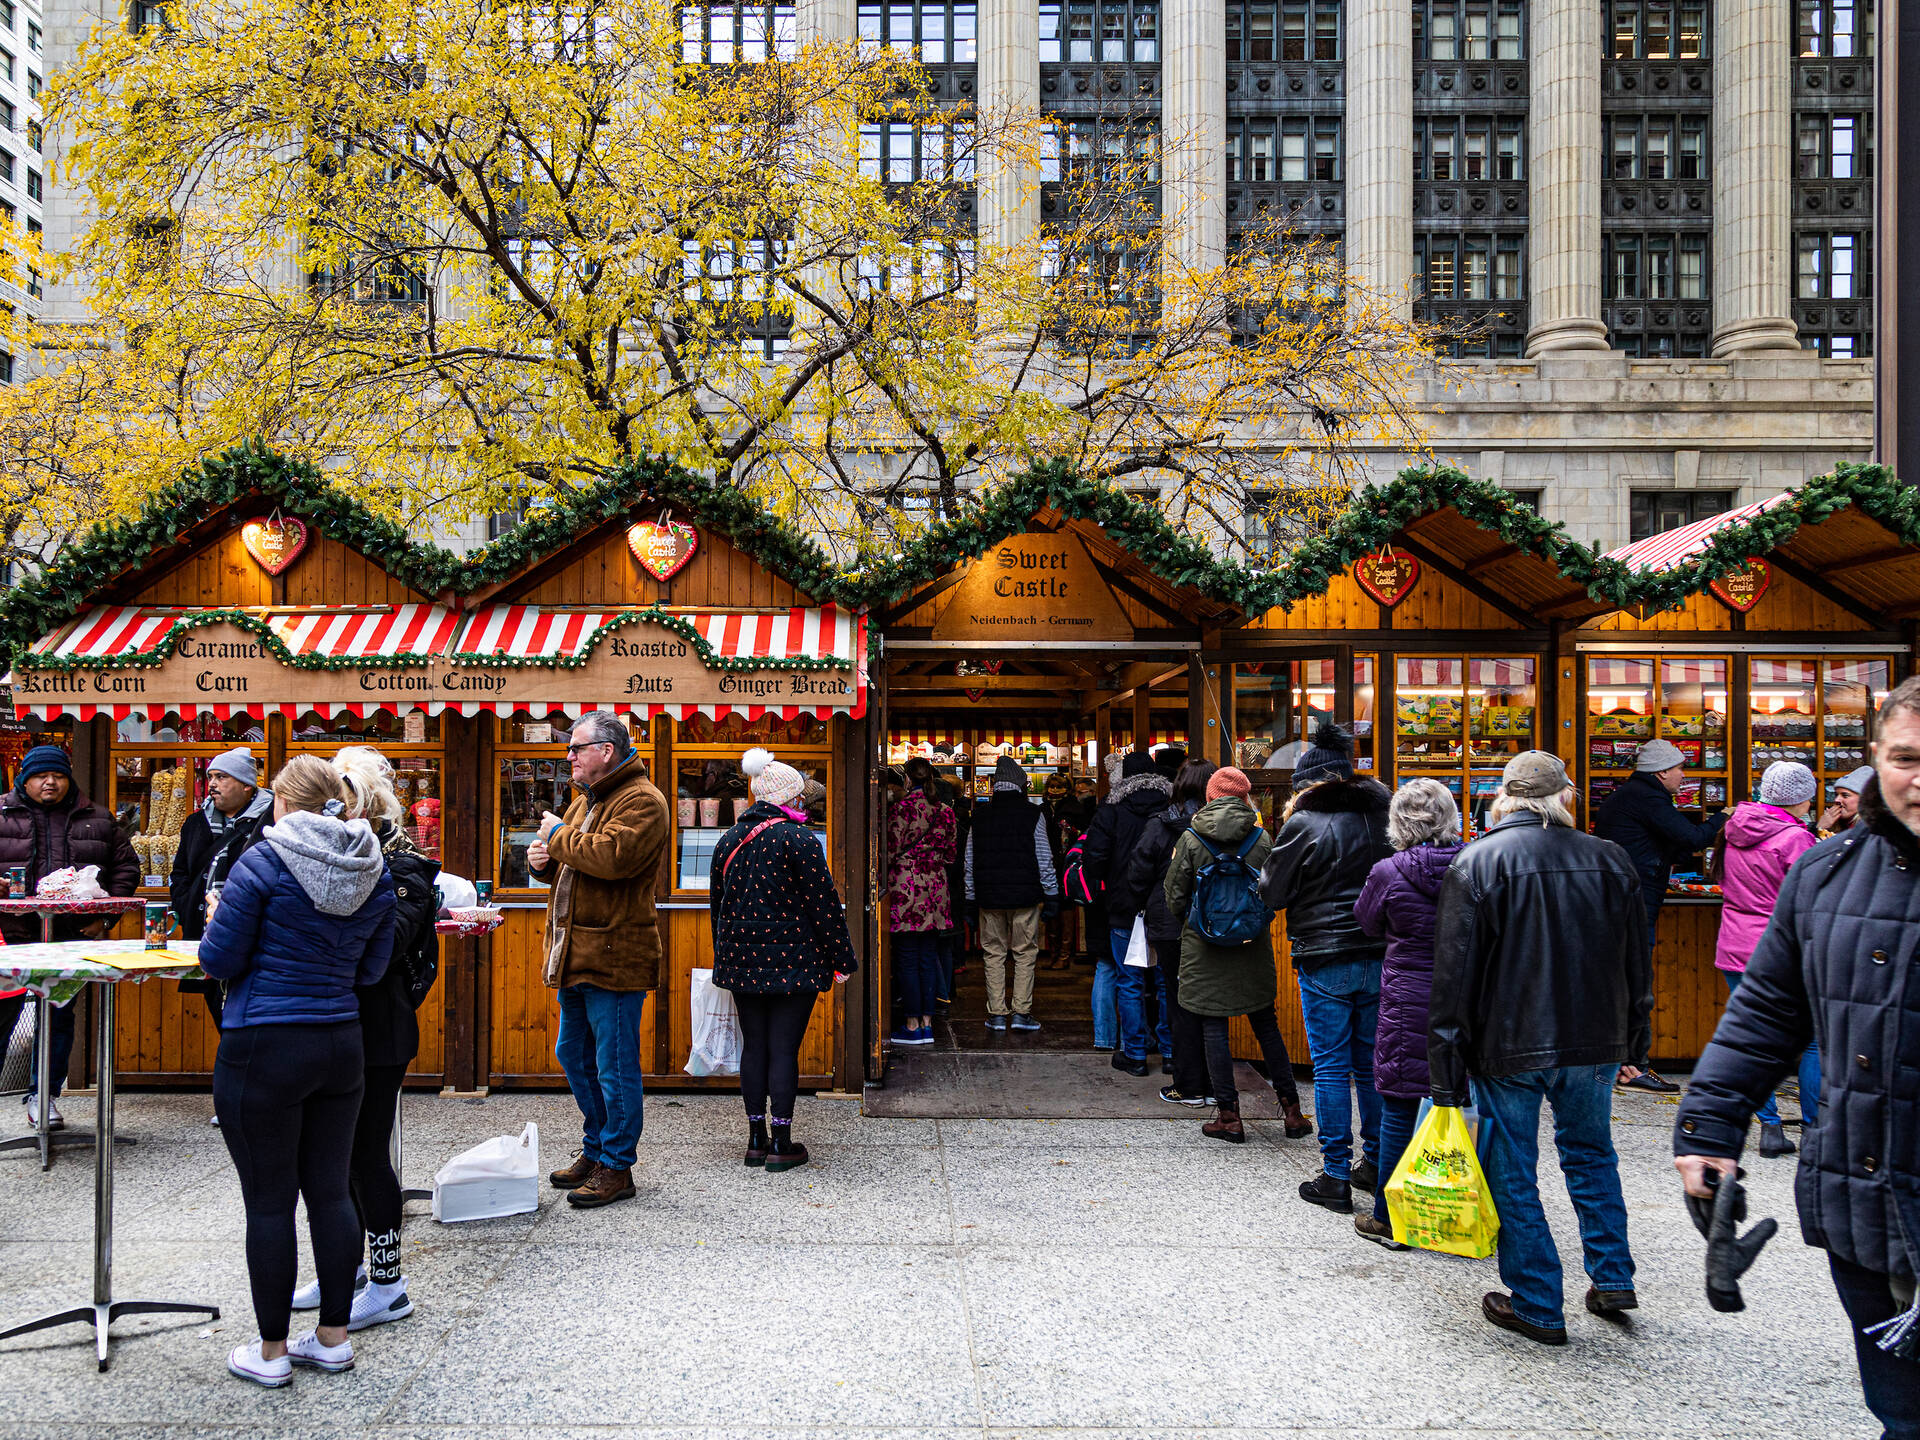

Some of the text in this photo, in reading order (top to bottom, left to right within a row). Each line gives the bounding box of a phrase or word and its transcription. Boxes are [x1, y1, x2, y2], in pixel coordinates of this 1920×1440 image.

[262, 541, 283, 550] Castle
[263, 530, 284, 542] Sweet
[648, 535, 676, 546] Sweet
[648, 546, 676, 557] Castle
[997, 547, 1068, 570] Sweet
[1375, 566, 1397, 577] Sweet
[1375, 576, 1396, 585] Castle
[1728, 571, 1754, 583] Sweet
[994, 576, 1069, 597] Castle
[1728, 582, 1755, 592] Castle
[970, 615, 1037, 625] Neidenbach
[1049, 615, 1095, 628] Germany
[178, 637, 266, 659] Caramel
[610, 638, 687, 658] Roasted
[22, 672, 87, 693] Kettle
[93, 671, 146, 692] Corn
[196, 671, 248, 692] Corn
[360, 672, 507, 695] Cotton Candy
[624, 674, 674, 694] Nuts
[719, 674, 848, 697] Ginger Bread
[371, 1245, 401, 1264] Klei
